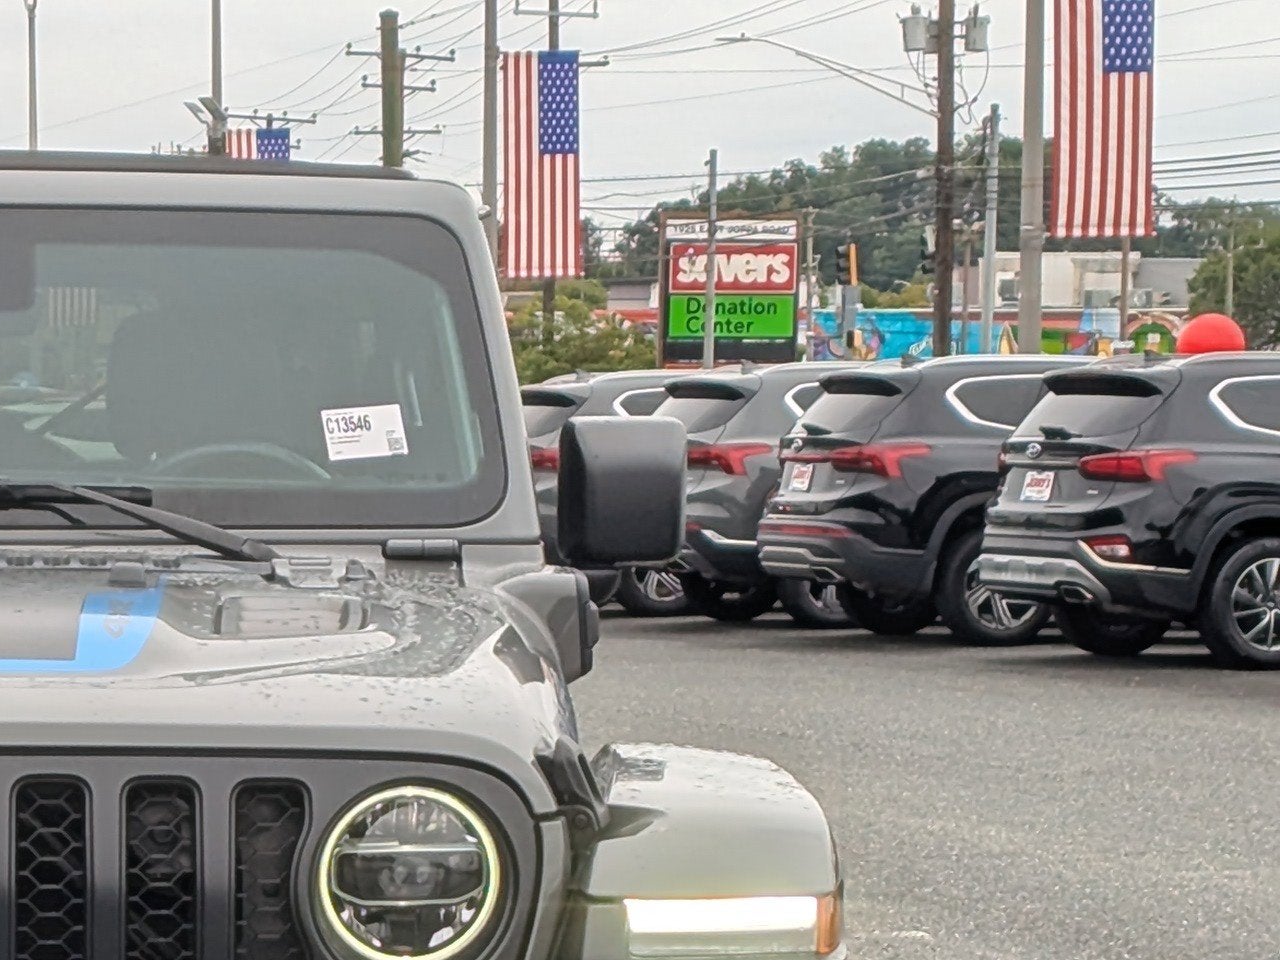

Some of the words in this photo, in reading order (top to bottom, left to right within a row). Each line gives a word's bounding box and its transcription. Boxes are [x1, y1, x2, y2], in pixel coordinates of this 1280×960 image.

[686, 297, 778, 316] Dnation
[686, 316, 755, 335] Cnter
[325, 414, 372, 435] C13546
